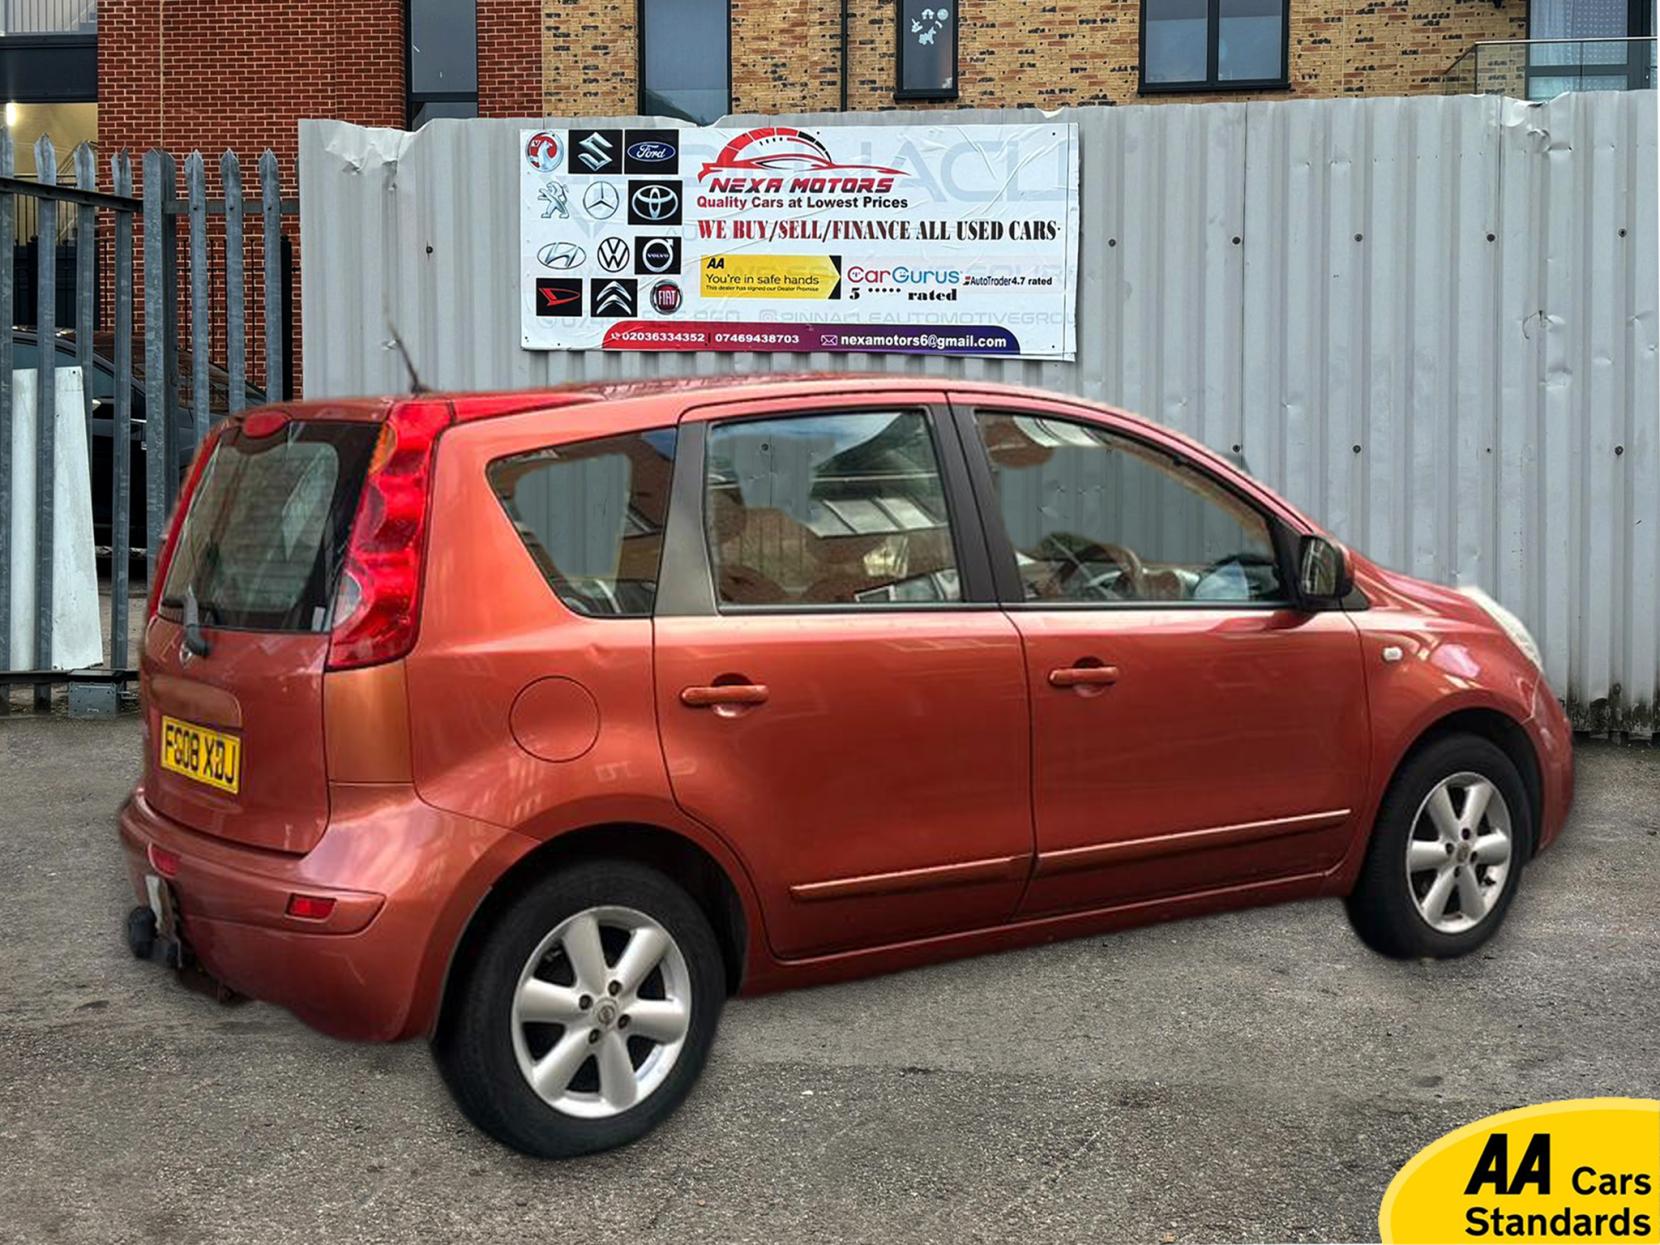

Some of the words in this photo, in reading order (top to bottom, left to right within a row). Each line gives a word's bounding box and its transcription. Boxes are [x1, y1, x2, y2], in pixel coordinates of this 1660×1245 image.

[636, 145, 666, 159] Ford
[709, 178, 783, 194] NEXA
[790, 178, 895, 194] MOTORS
[697, 196, 747, 211] Quality
[752, 196, 784, 208] Cars
[789, 197, 802, 208] at
[807, 196, 859, 209] Lowest
[863, 196, 908, 209] Prices
[697, 220, 726, 240] WE
[916, 221, 951, 240] ALL
[957, 221, 1003, 241] USED
[707, 257, 725, 269] AA
[706, 274, 741, 284] You're
[744, 274, 754, 284] in
[757, 274, 781, 285] safe
[781, 275, 820, 285] hands
[847, 266, 960, 285] CarGurus
[1028, 277, 1052, 286] rated
[658, 290, 677, 305] FIAT
[908, 288, 958, 301] rated
[622, 333, 705, 342] 02036334352
[715, 333, 800, 343] 07469438703
[841, 334, 1007, 349] nexamotors6@gmail.com
